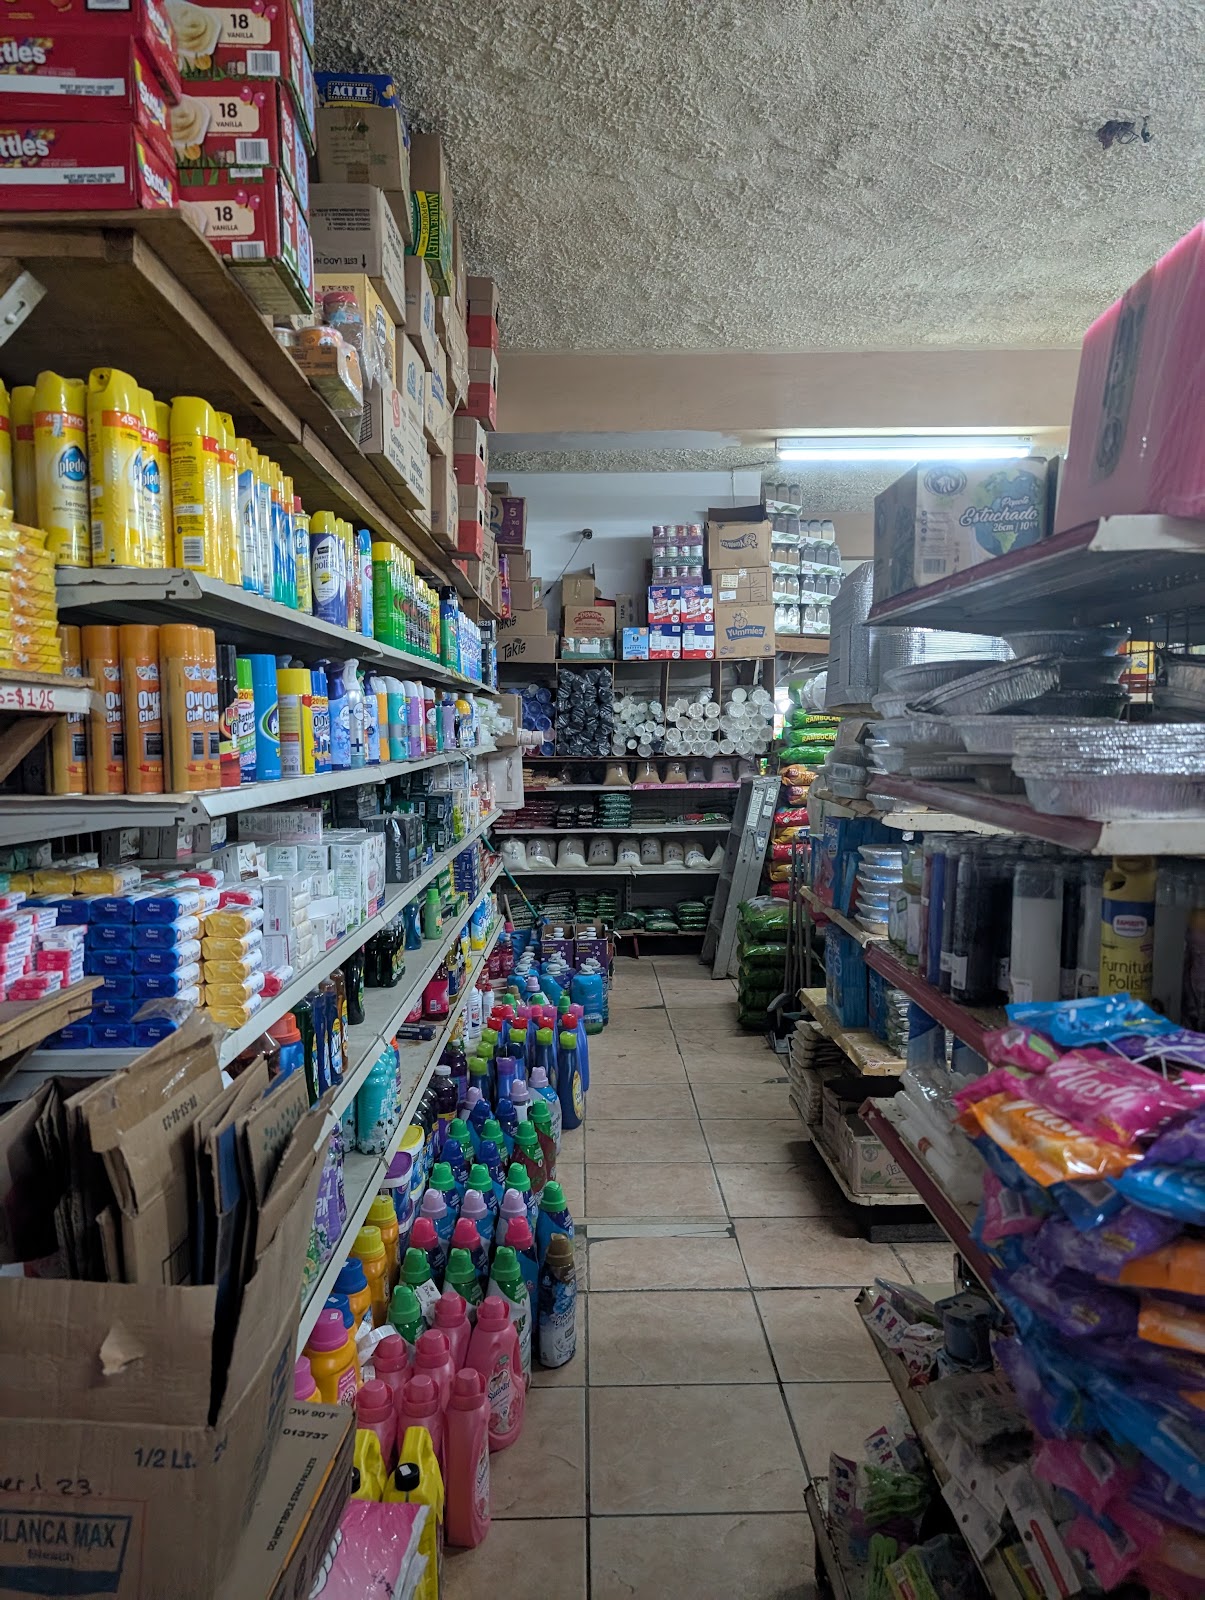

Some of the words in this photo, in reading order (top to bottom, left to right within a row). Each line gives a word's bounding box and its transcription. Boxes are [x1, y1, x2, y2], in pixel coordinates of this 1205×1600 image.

[230, 14, 249, 29] 18
[0, 41, 46, 64] tles
[332, 87, 353, 97] ACT
[219, 103, 238, 118] 18
[214, 206, 234, 221] 18
[426, 193, 439, 225] NATURE
[426, 226, 439, 256] VALLEY
[324, 257, 342, 265] LADO
[344, 257, 358, 265] ESTE
[510, 507, 517, 517] 5
[960, 506, 1038, 527] Estuchado
[993, 523, 1014, 532] 26cm
[727, 627, 764, 637] Yummies
[502, 641, 526, 661] Takis
[283, 1428, 329, 1441] 013737
[135, 1448, 166, 1468] 1/2
[0, 1516, 68, 1546] LANCA
[74, 1521, 115, 1552] MAX
